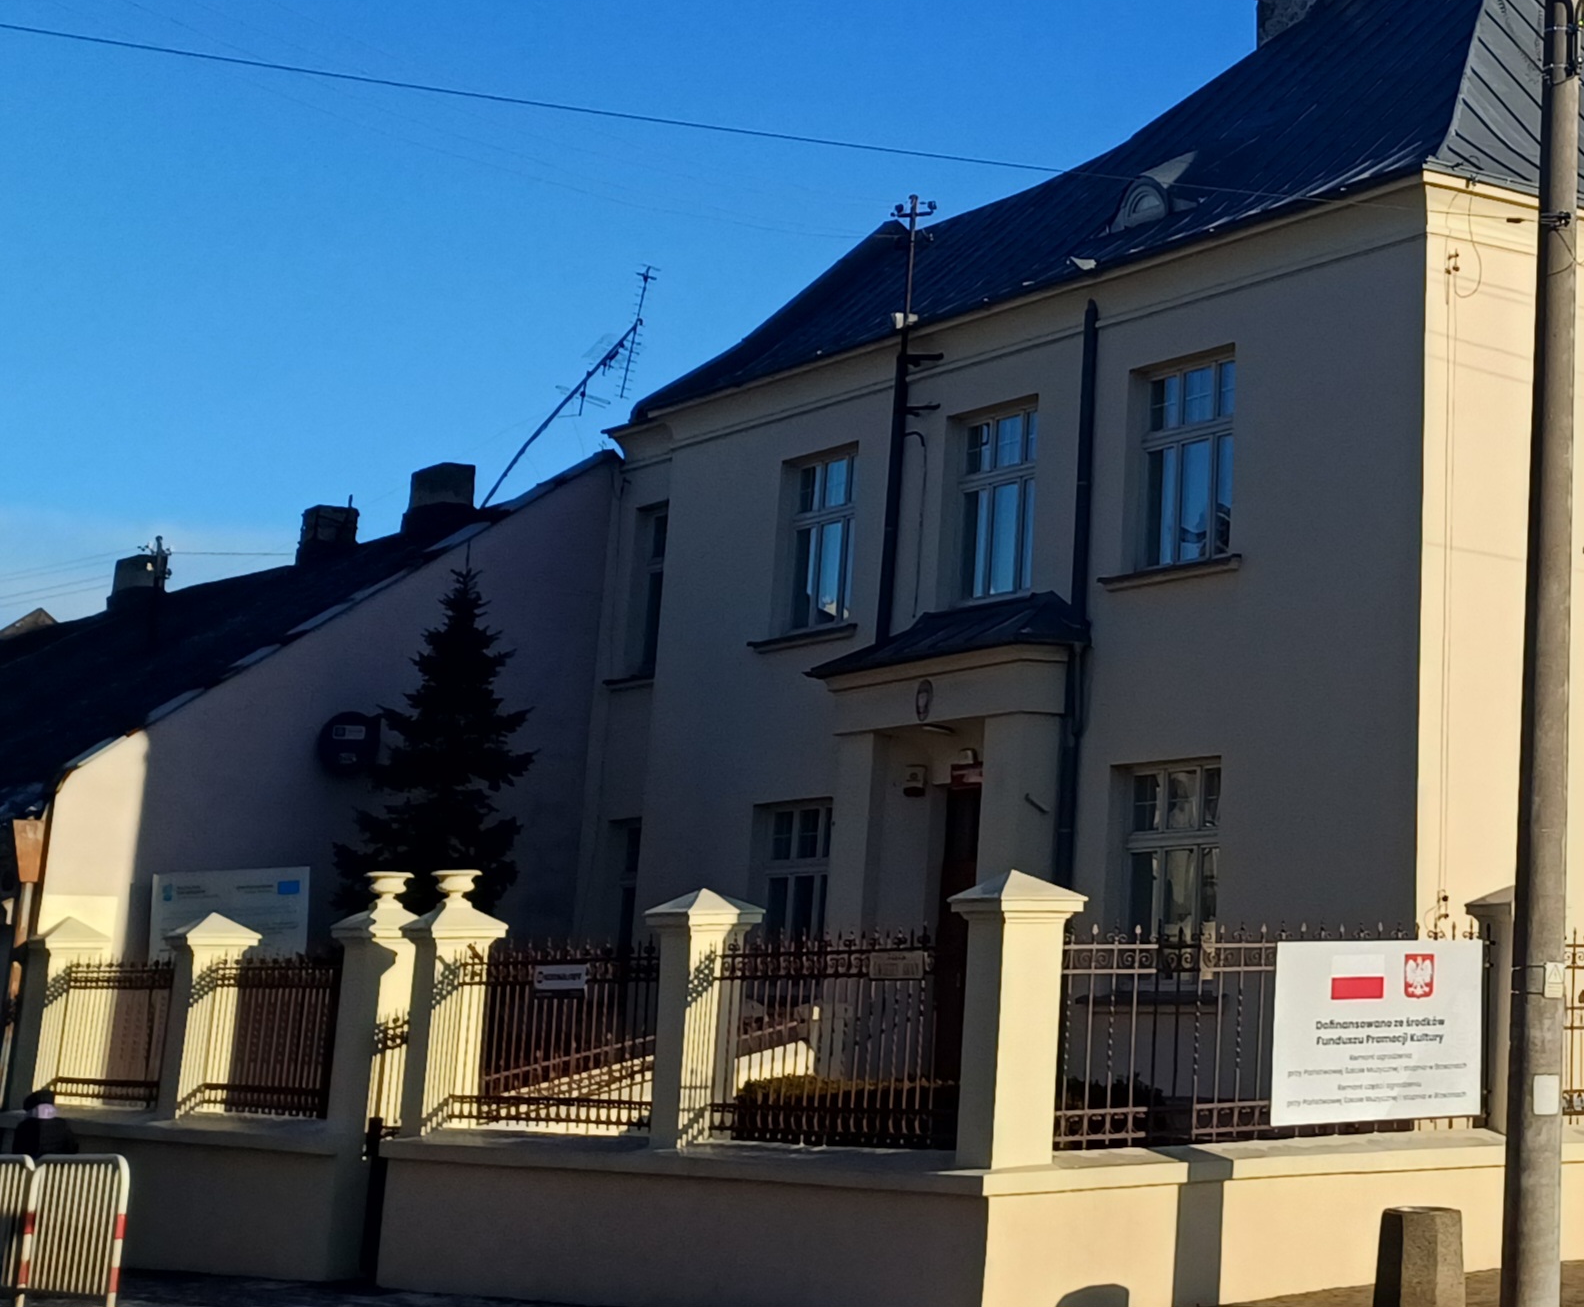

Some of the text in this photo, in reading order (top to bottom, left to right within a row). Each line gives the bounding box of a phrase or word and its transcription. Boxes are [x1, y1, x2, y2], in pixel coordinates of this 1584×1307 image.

[1315, 1016, 1445, 1030] Dofinansowano ze środków
[1316, 1032, 1444, 1046] Funduszu Promocji Kultury
